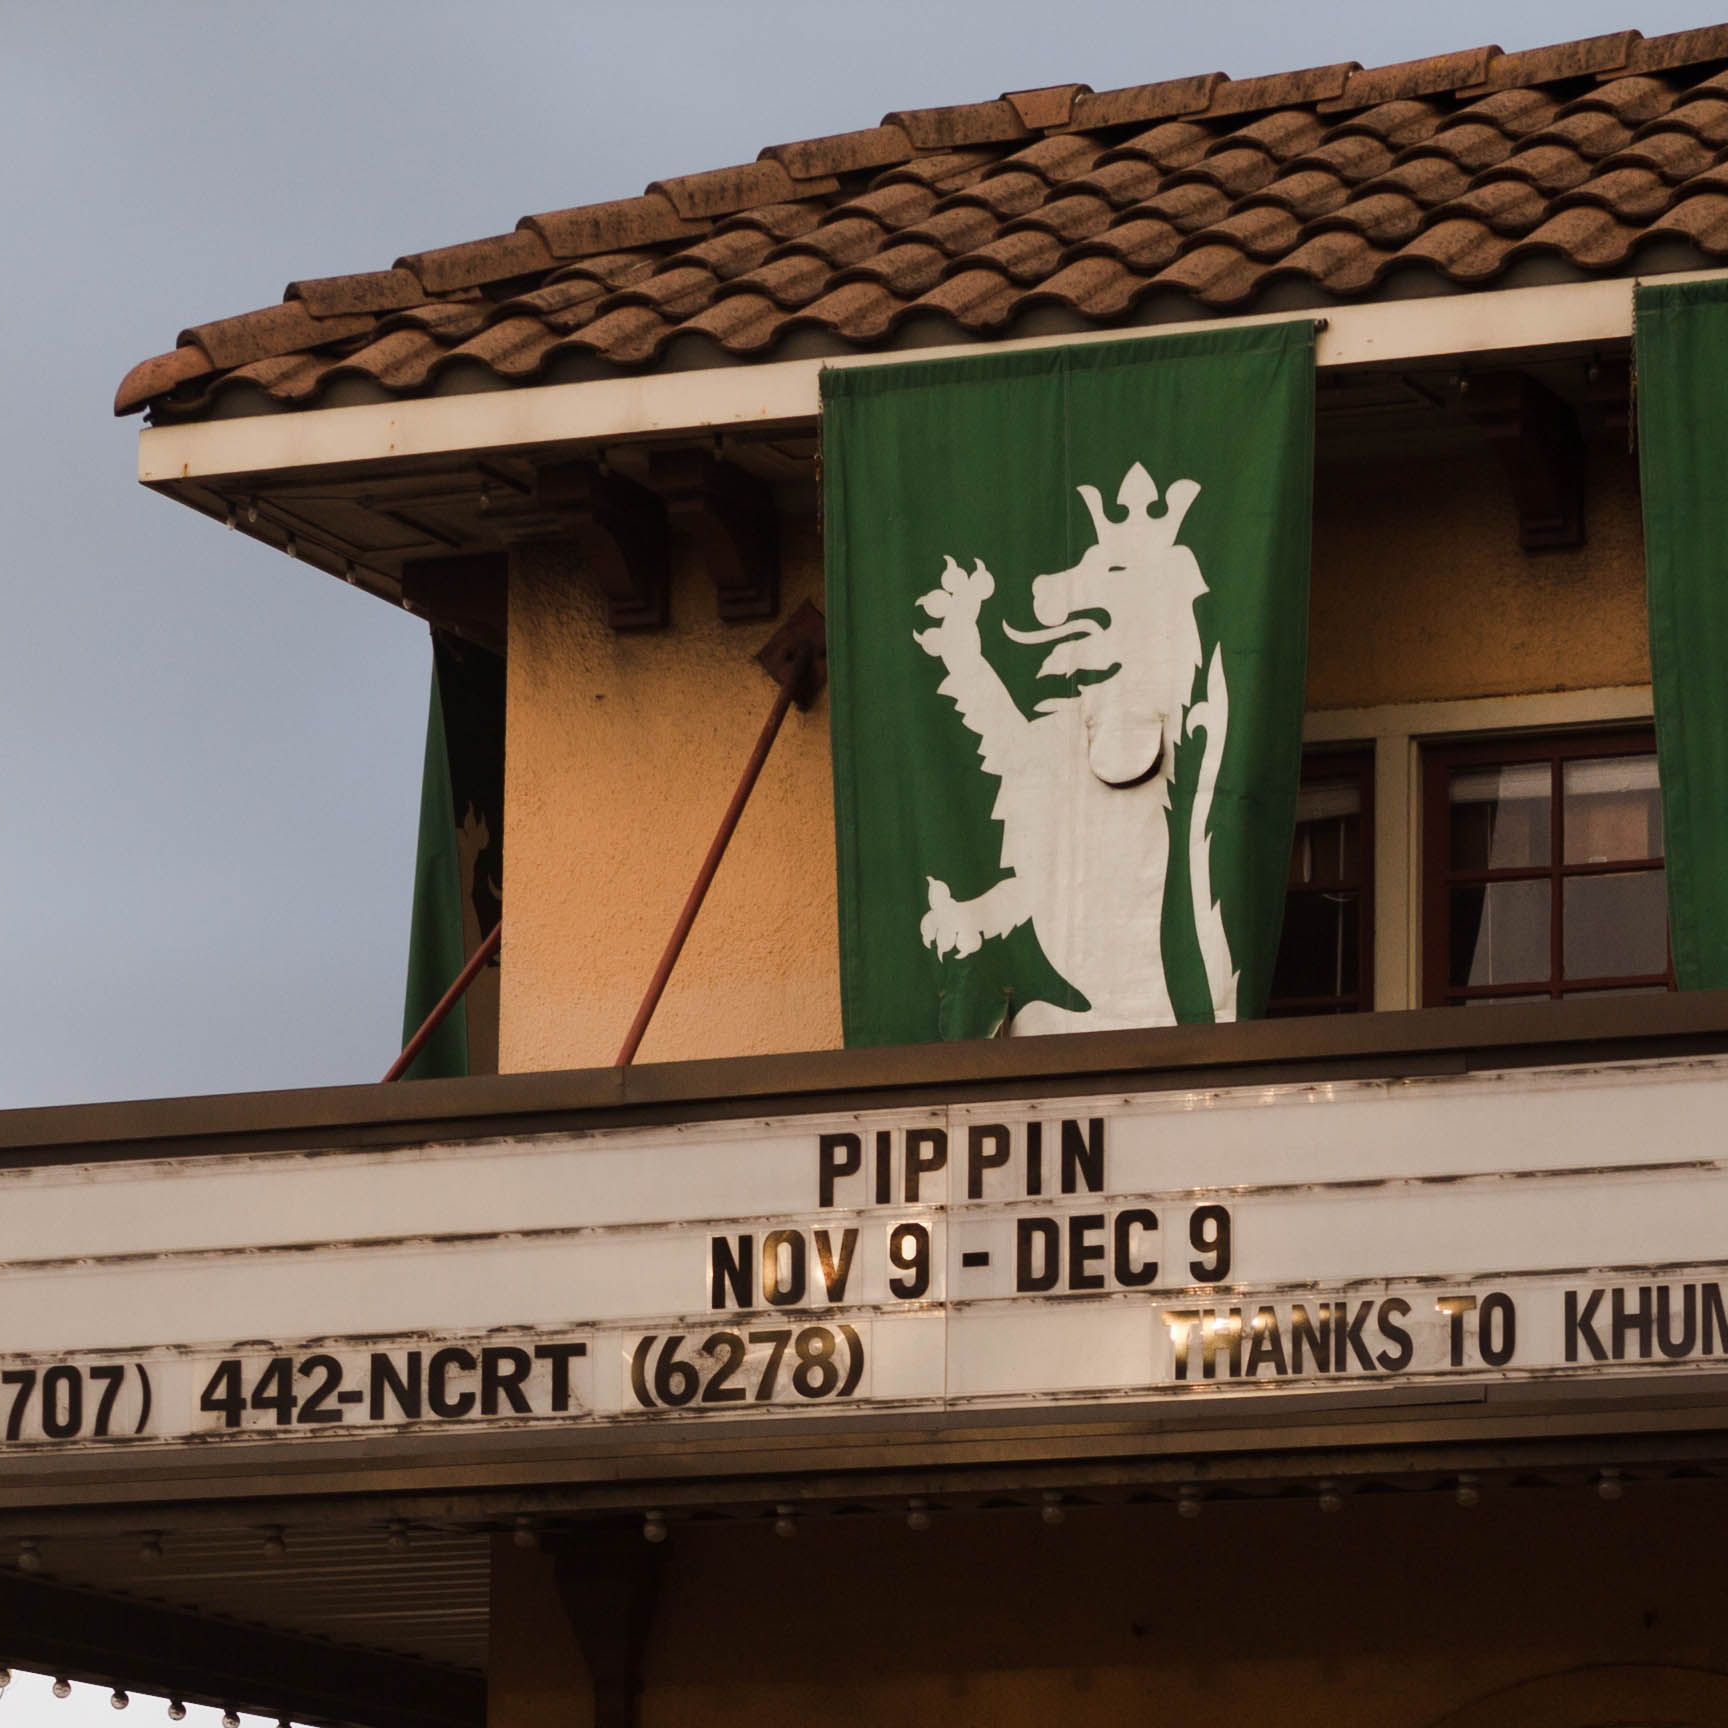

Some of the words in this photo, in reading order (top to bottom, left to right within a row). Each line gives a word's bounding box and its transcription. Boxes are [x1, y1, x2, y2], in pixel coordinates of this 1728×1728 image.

[818, 1117, 1105, 1208] PIPPIN
[710, 1227, 860, 1310] NOV
[888, 1222, 931, 1300] 9
[1016, 1208, 1159, 1294] DEC
[1188, 1203, 1232, 1284] 9
[200, 1342, 588, 1429] 442-NCRT
[630, 1324, 865, 1409] (6278)
[1162, 1296, 1415, 1381] THANKS
[1436, 1291, 1516, 1368] TO
